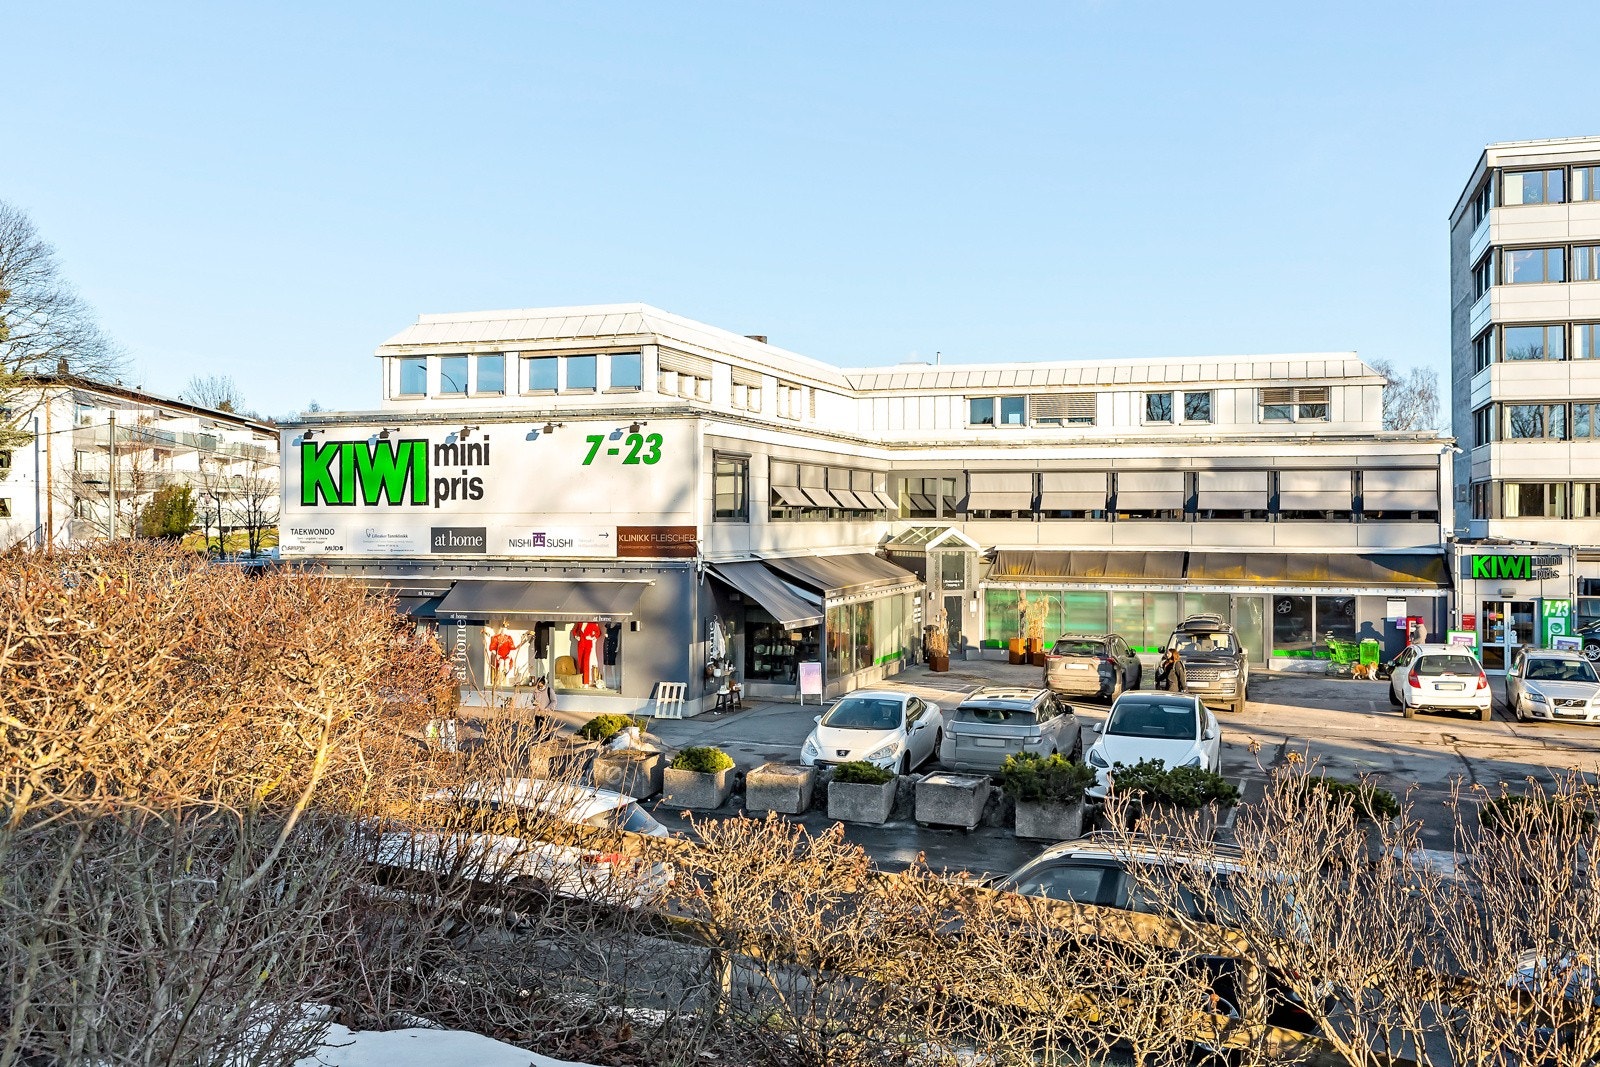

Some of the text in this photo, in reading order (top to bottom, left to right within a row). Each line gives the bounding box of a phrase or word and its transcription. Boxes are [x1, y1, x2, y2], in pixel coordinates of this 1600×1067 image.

[434, 435, 490, 466] mini
[301, 439, 429, 506] KIWI
[434, 469, 484, 508] pris
[290, 528, 335, 536] TAEKWONDO
[434, 530, 483, 547] at home
[532, 532, 546, 548] 西
[618, 533, 696, 542] KLINIKK FLEISCHER
[508, 539, 531, 548] NISHI
[546, 539, 573, 548] SUSHI
[1472, 554, 1532, 580] KIWI
[1536, 568, 1560, 580] pris
[1544, 600, 1569, 617] 7-23
[452, 619, 466, 680] at home
